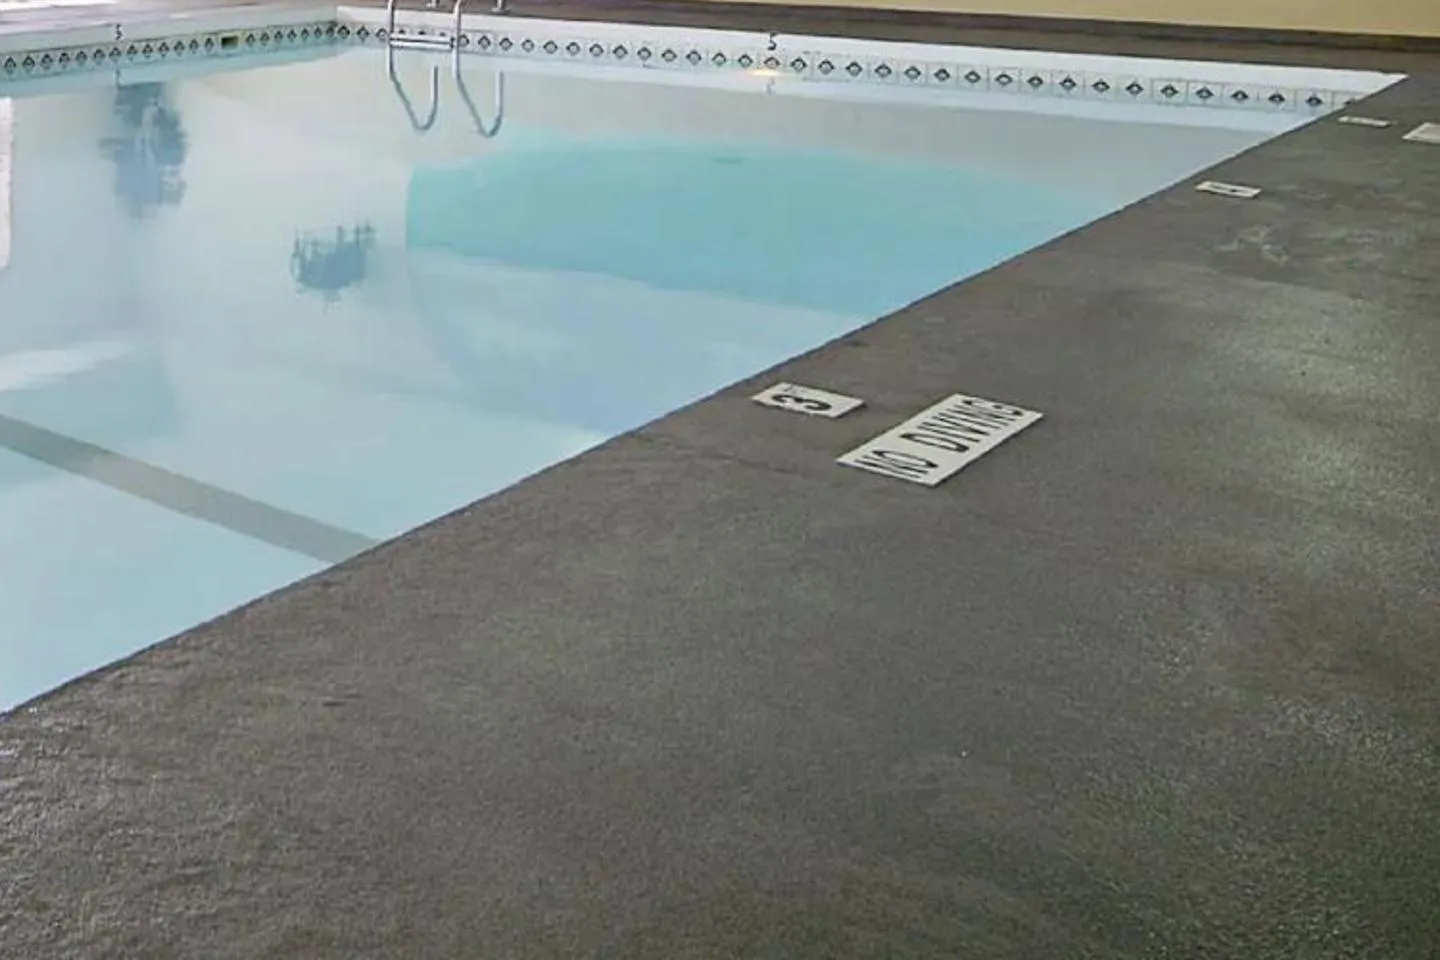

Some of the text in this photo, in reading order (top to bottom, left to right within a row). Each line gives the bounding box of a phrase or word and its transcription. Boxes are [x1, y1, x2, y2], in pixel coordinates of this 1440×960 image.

[767, 31, 777, 51] 5
[771, 394, 832, 411] 3
[854, 398, 1024, 479] NO DIVING
